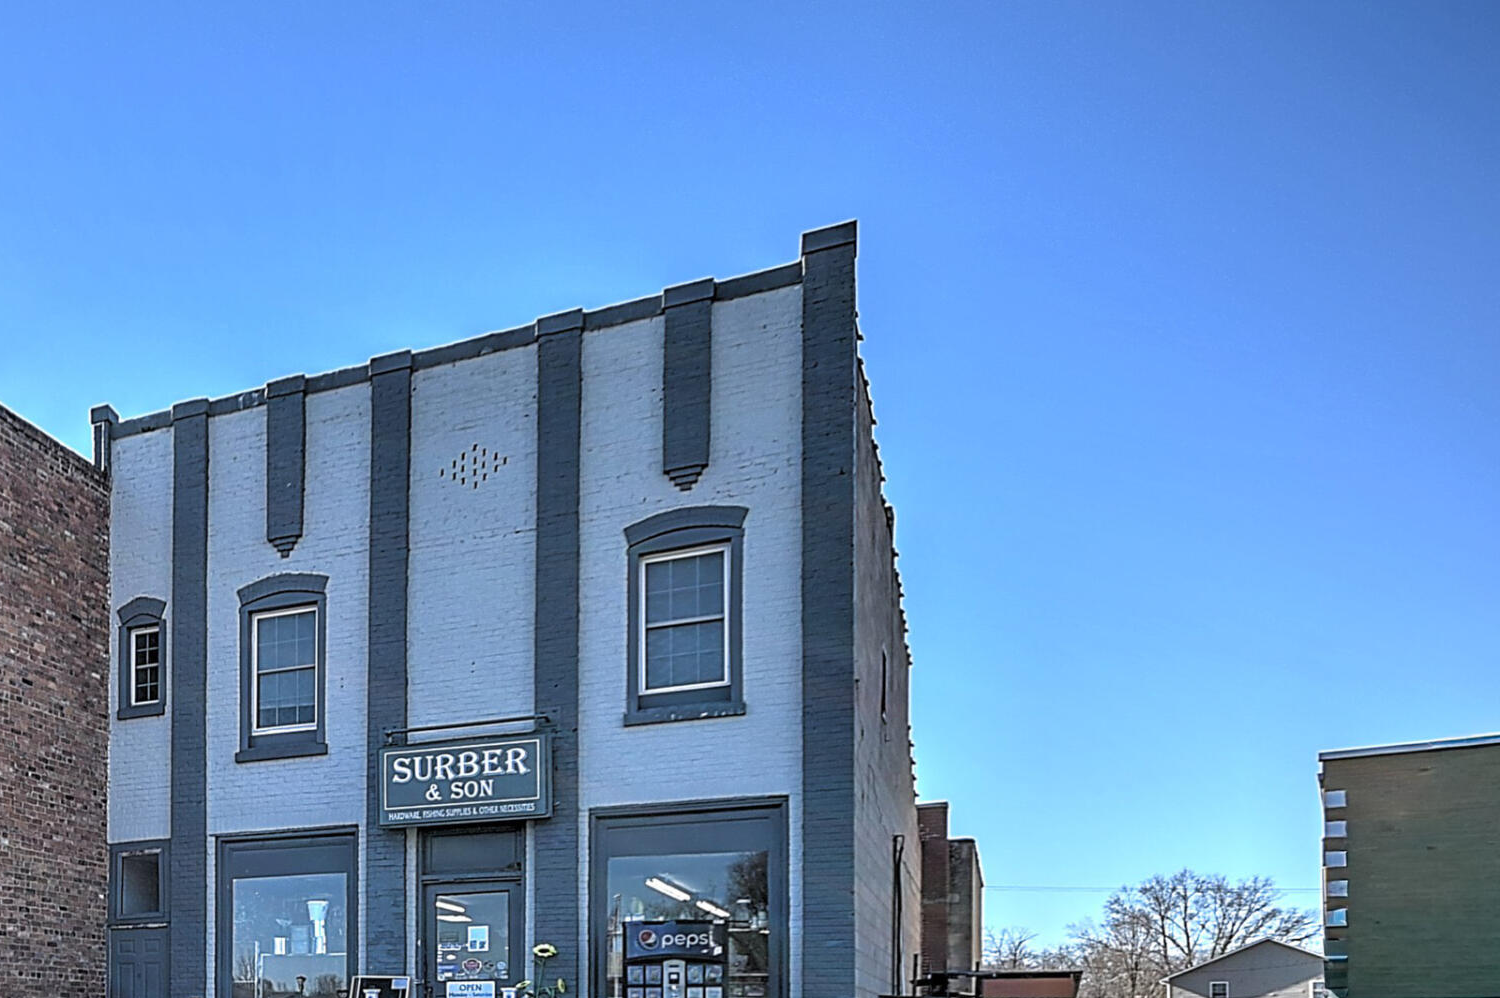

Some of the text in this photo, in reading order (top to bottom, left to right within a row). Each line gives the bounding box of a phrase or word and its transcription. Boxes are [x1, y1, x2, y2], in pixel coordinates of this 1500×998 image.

[392, 748, 531, 783] SURBER
[425, 779, 494, 801] & SON
